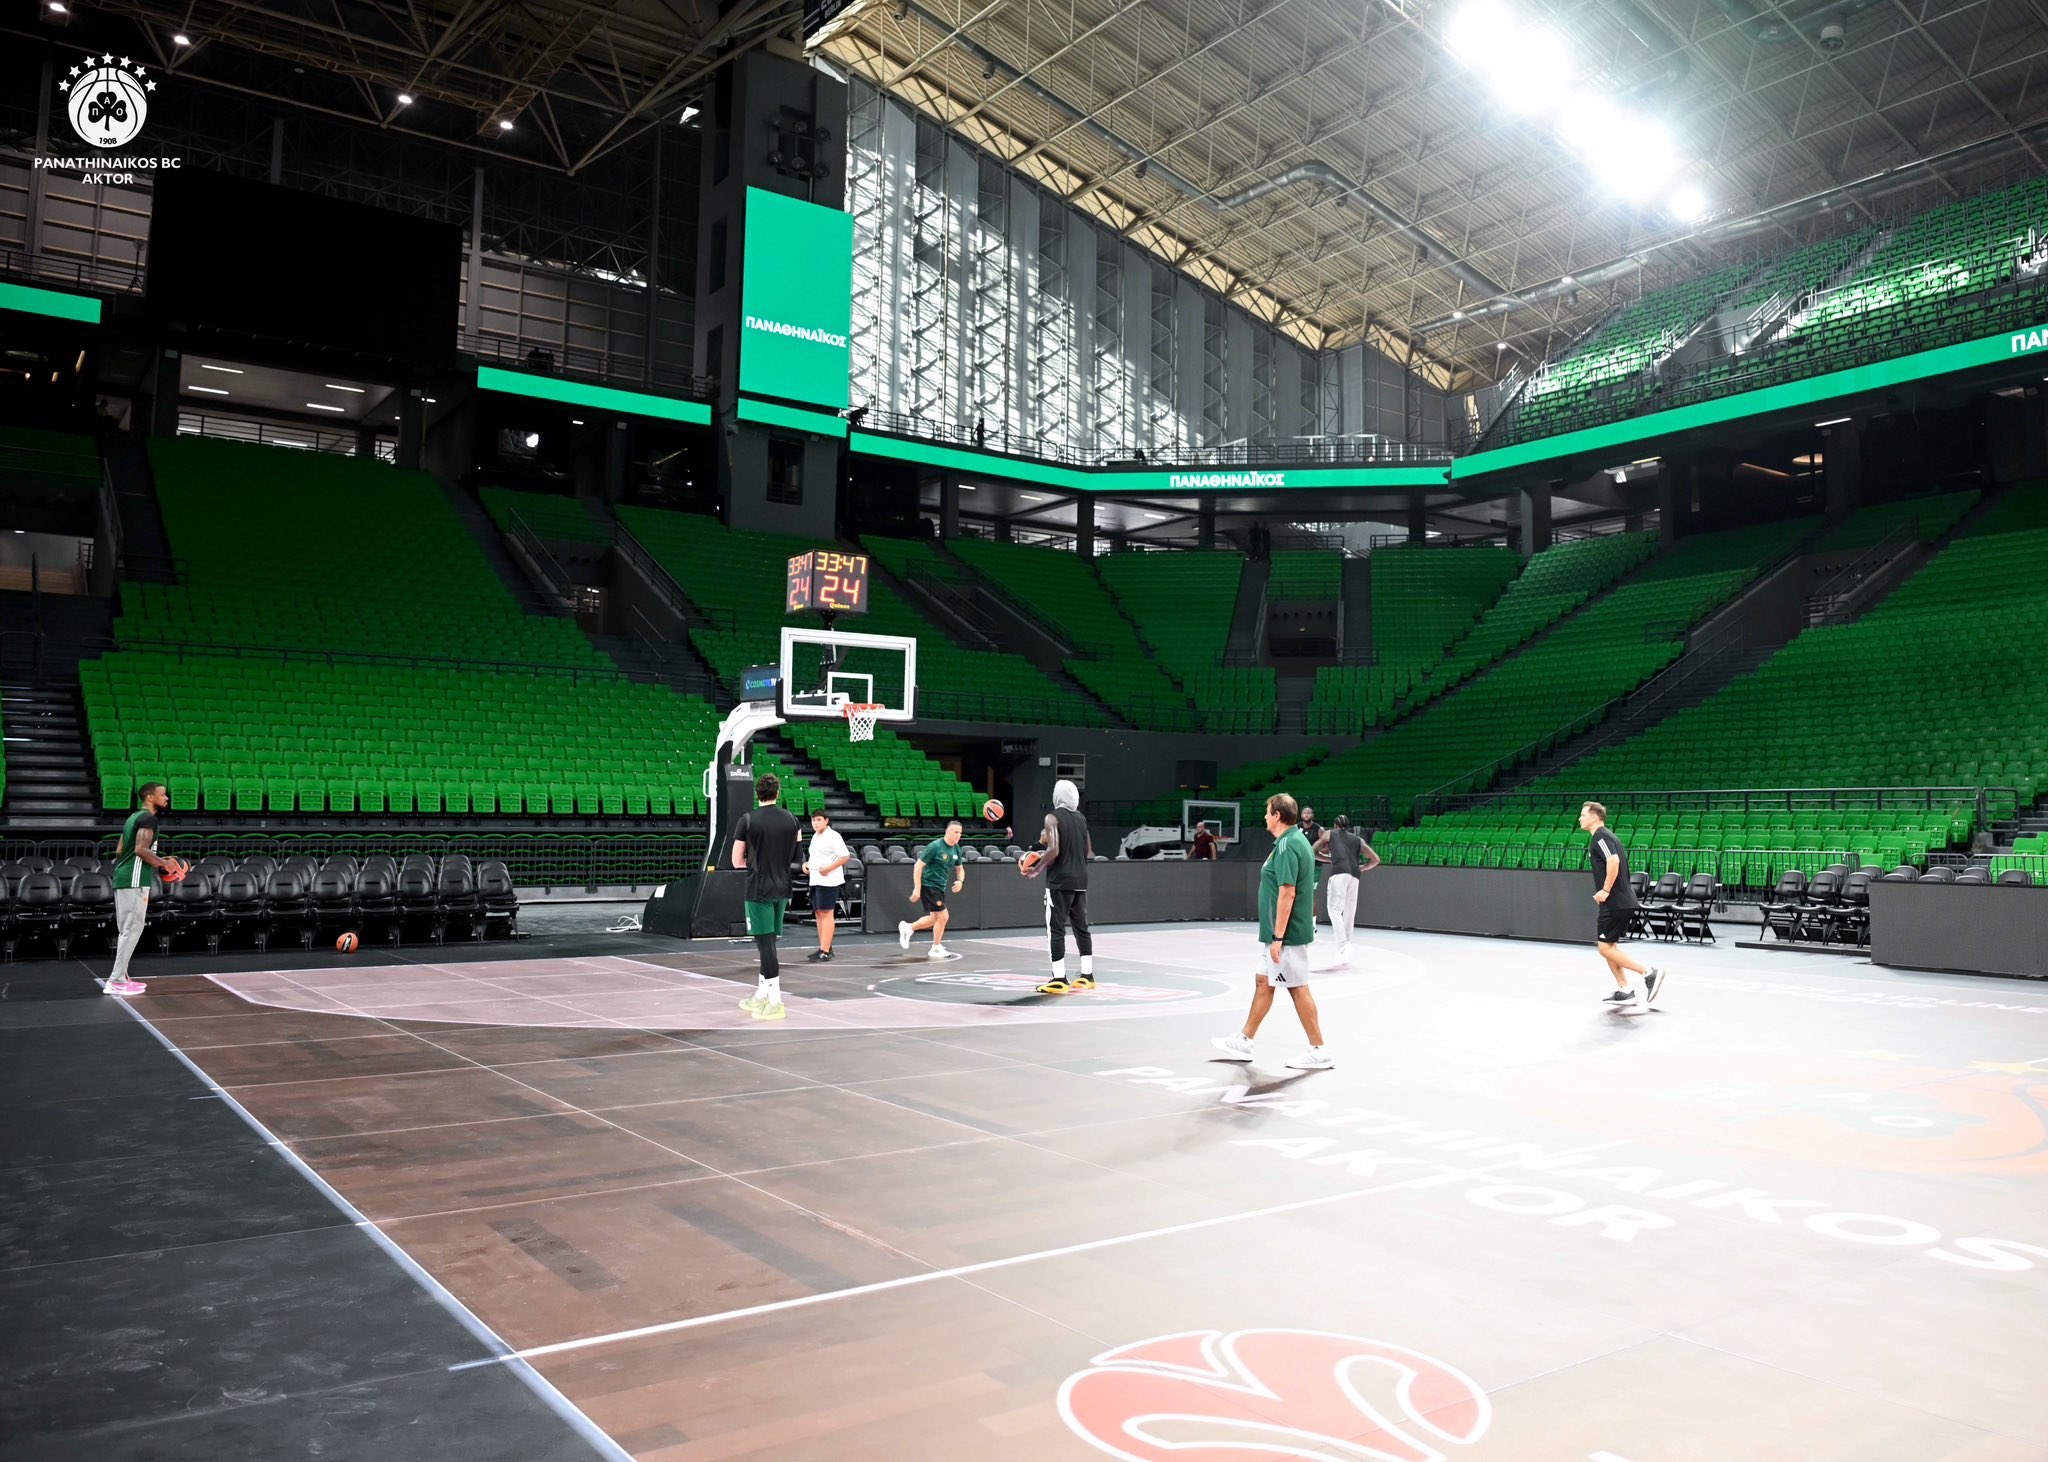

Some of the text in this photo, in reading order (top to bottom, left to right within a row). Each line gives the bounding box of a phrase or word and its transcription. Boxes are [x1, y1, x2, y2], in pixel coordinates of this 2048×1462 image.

[745, 315, 847, 348] ΠΑΝΑΘΗΝΑΪΚΟΣ
[1169, 470, 1285, 488] ΠΑΝΑΘΗΝΑΪΚΟΣ
[815, 551, 867, 575] 33:47
[789, 575, 810, 606] 24
[820, 575, 860, 604] 24
[1094, 1066, 2048, 1271] PANATHINAIKOS
[1230, 1136, 1675, 1242] AKTOR
